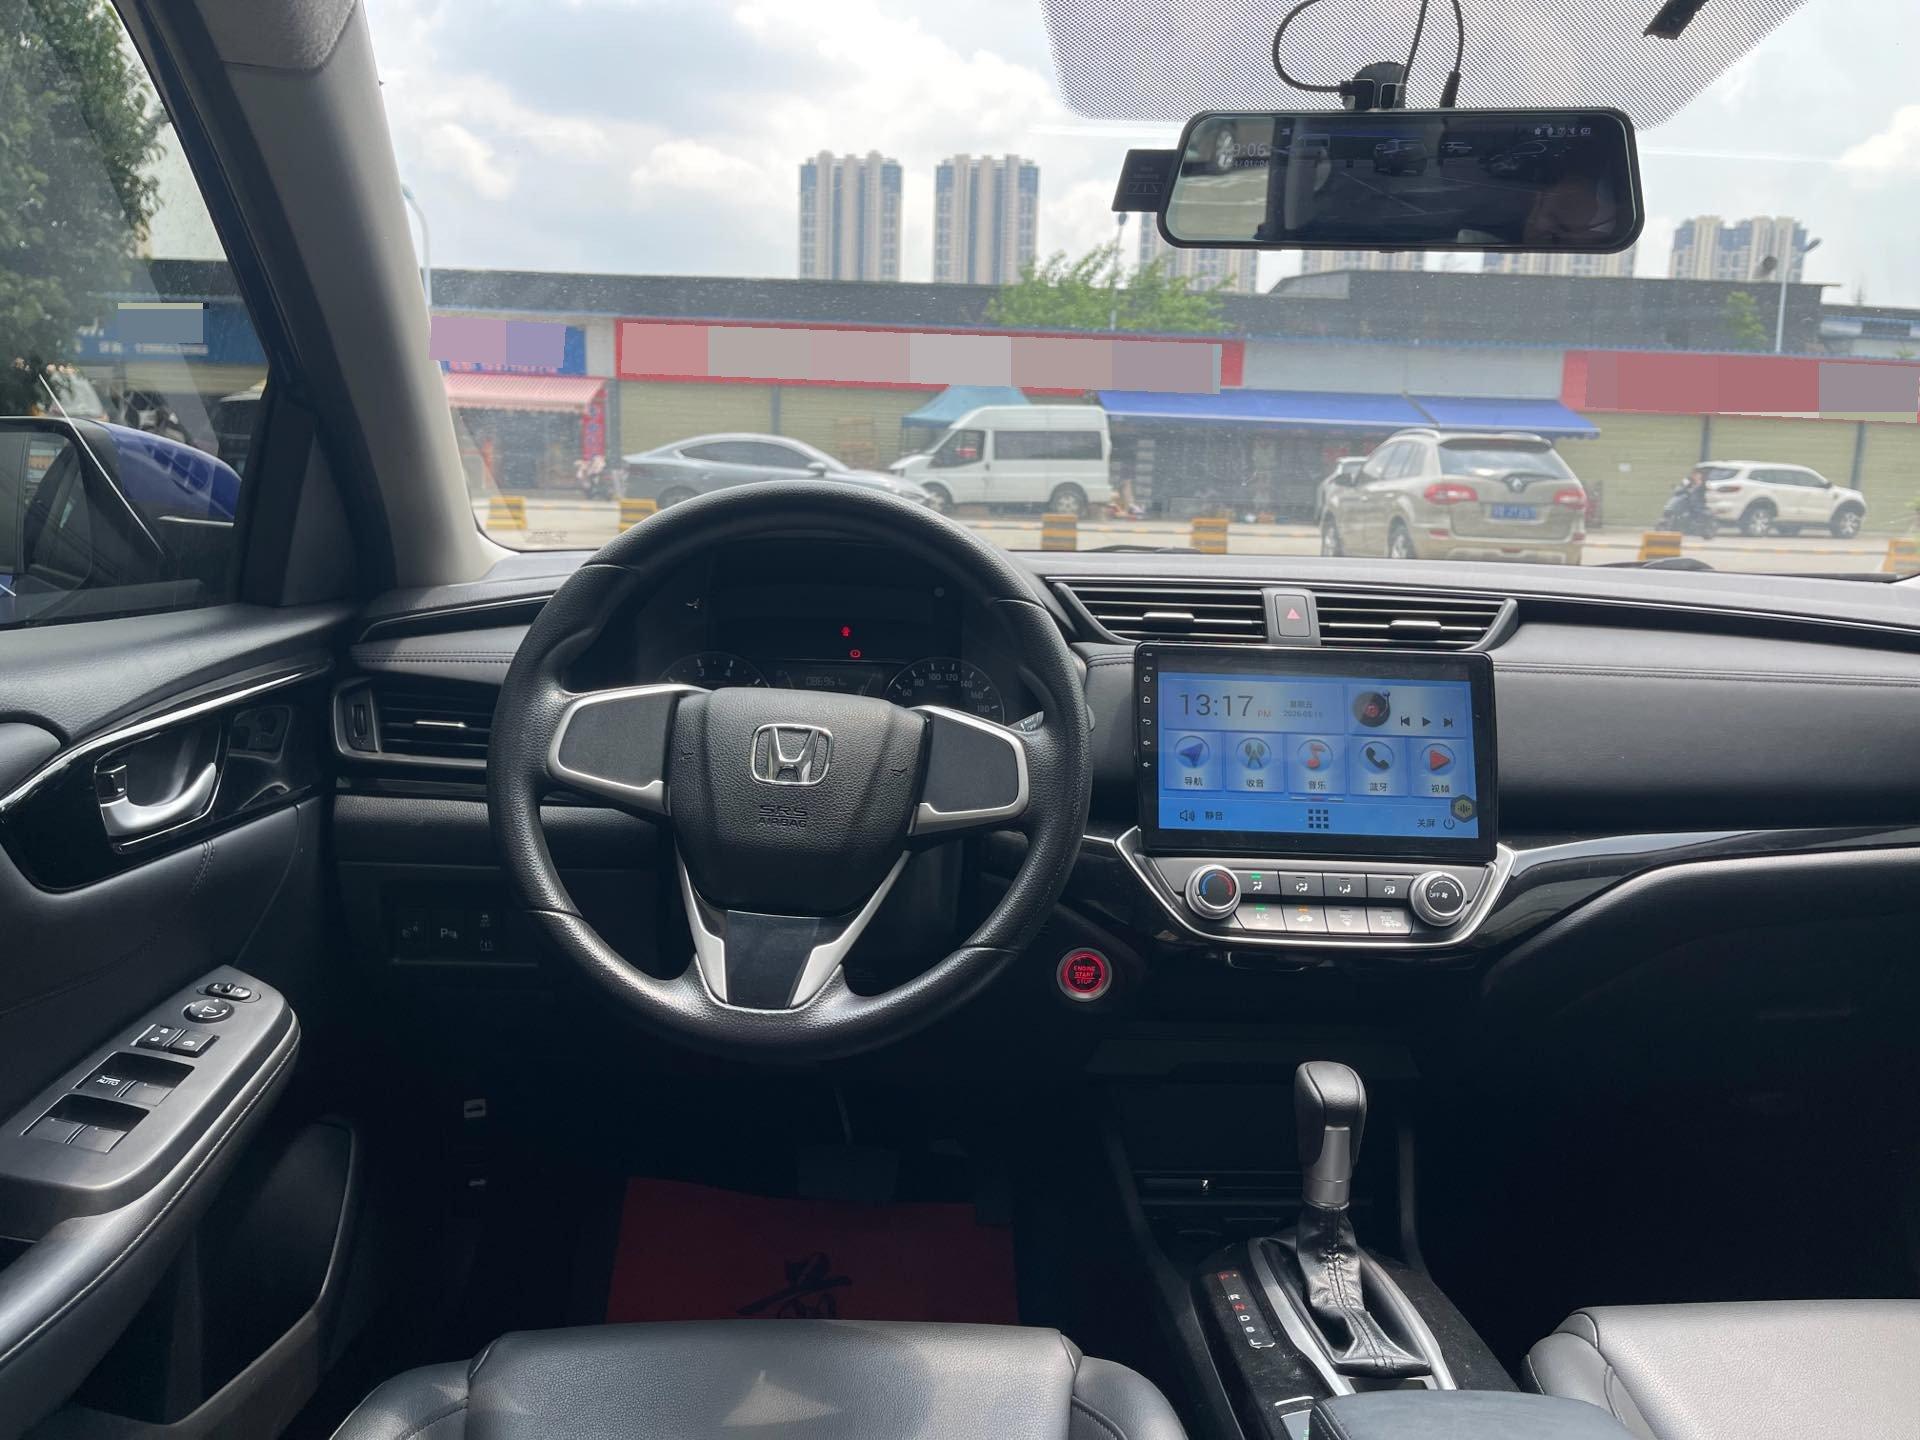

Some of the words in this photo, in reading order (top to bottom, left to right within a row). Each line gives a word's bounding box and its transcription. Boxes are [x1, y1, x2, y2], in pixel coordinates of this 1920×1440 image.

[1178, 694, 1254, 717] 13:17
[1257, 709, 1272, 718] PM
[1184, 776, 1203, 787] 导航
[1245, 778, 1265, 788] 收音
[1308, 780, 1327, 790] 音乐
[1369, 782, 1388, 792] 蓝牙
[1431, 784, 1450, 793] 视频
[759, 805, 807, 816] SRS
[1205, 811, 1224, 821] 静音
[1416, 818, 1436, 828] 关屏
